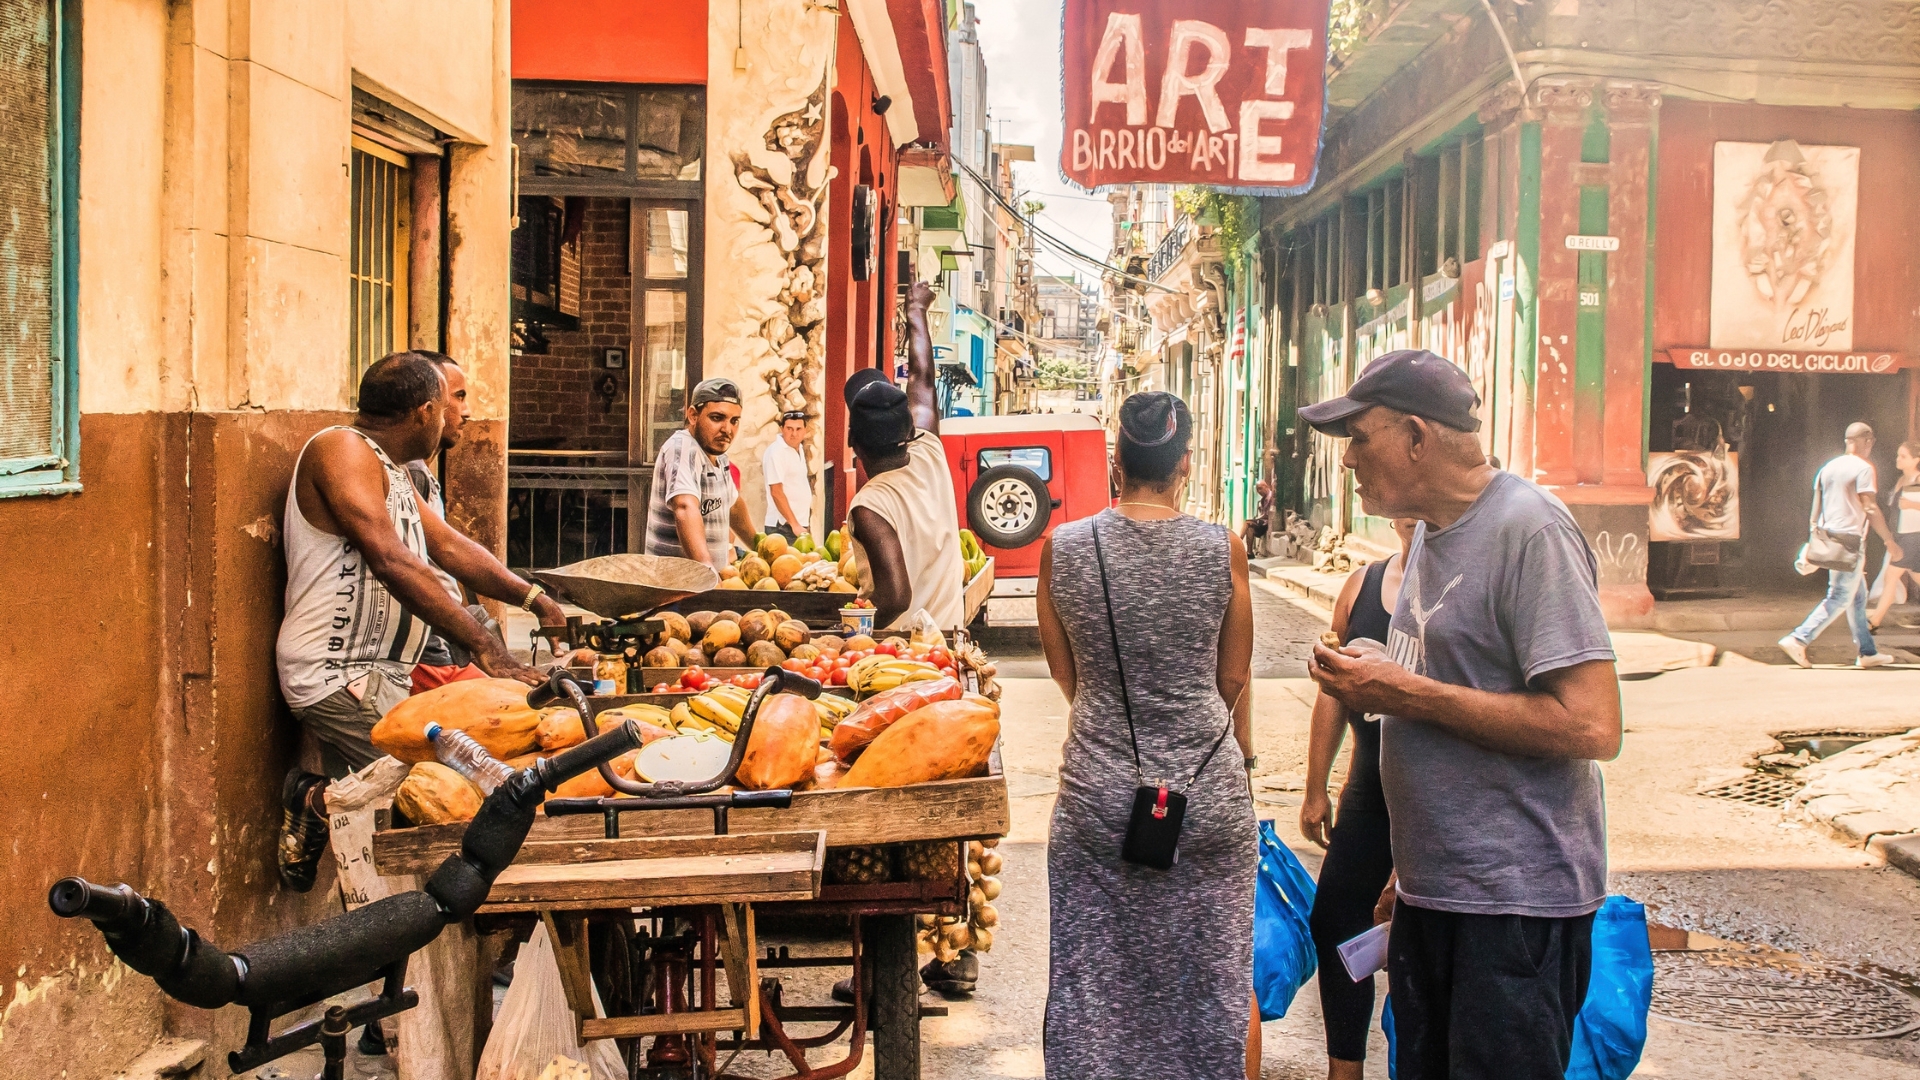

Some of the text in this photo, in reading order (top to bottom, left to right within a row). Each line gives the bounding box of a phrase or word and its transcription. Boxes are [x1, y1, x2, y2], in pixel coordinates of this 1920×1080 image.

[1580, 292, 1600, 306] 501
[1690, 351, 1714, 367] EL
[1718, 352, 1763, 368] OJO
[1766, 354, 1803, 370] DEL
